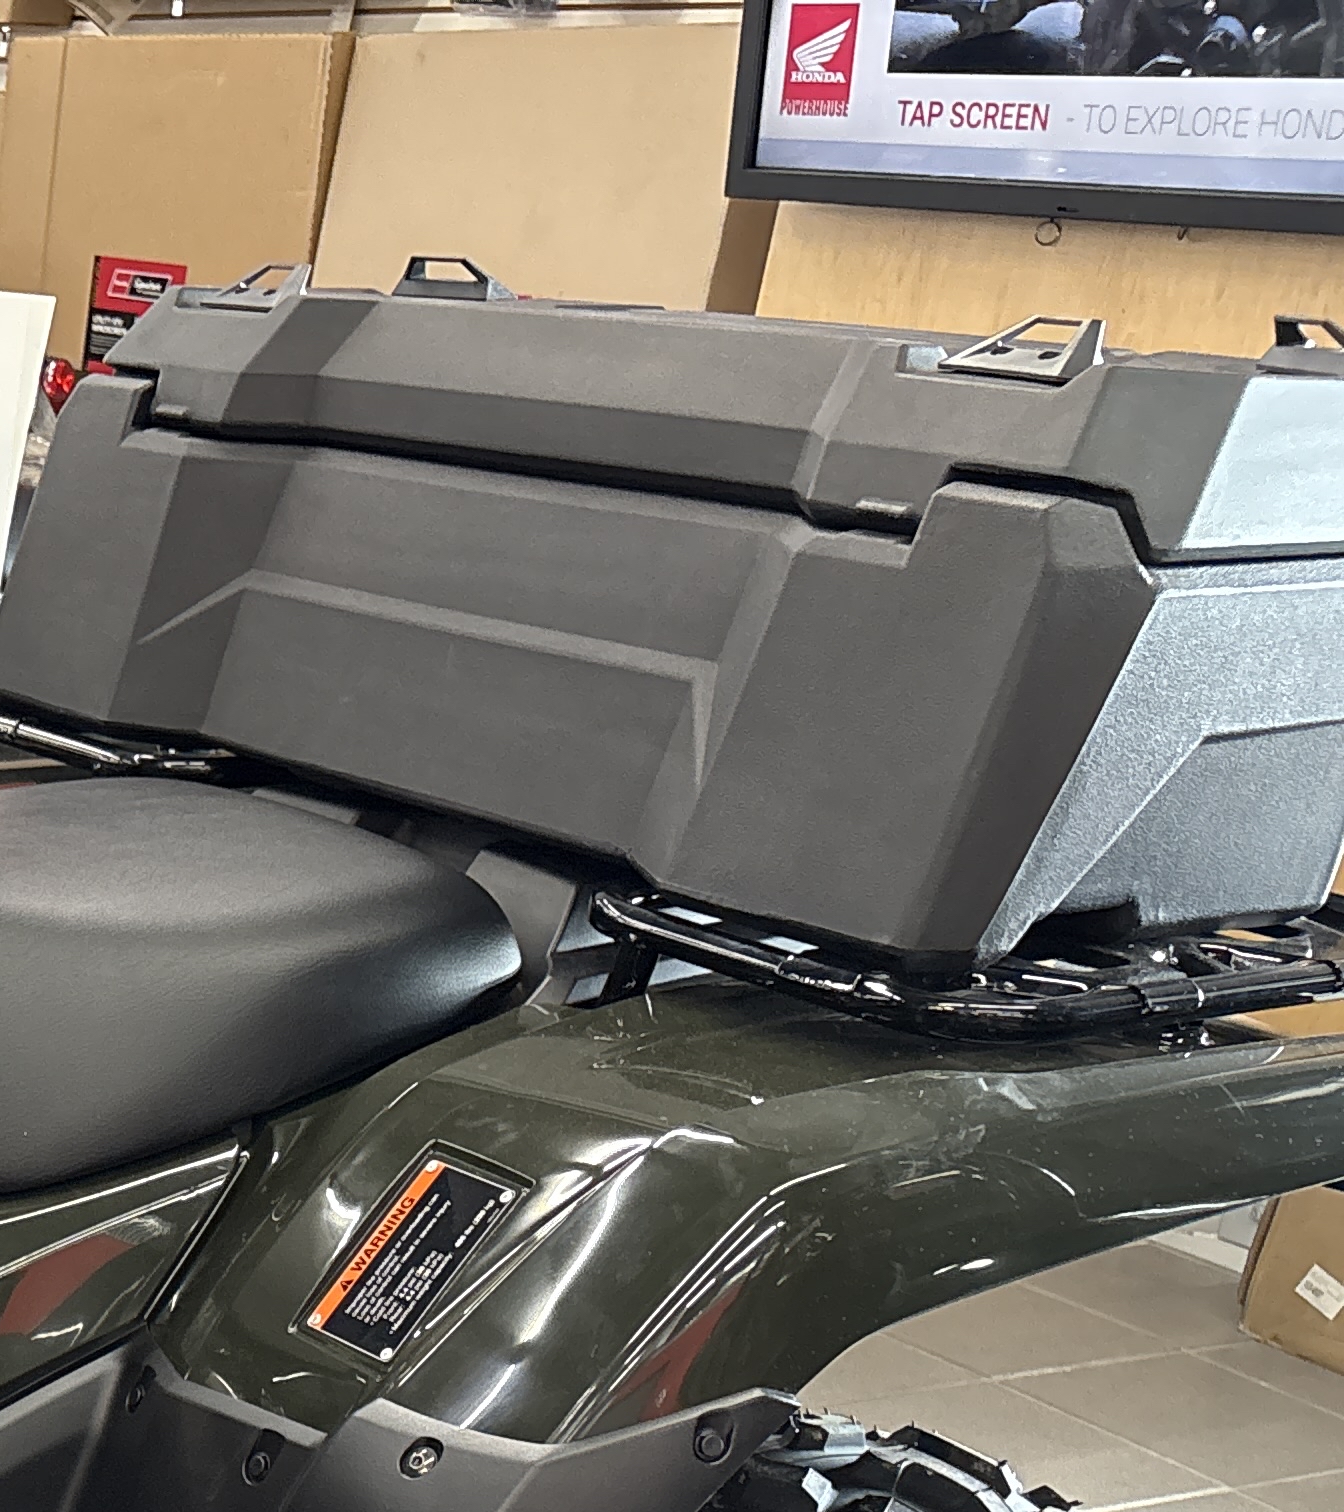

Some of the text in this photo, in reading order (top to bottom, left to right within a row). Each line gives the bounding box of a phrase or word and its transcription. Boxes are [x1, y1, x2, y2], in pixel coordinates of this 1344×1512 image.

[790, 71, 846, 84] HONDA
[780, 99, 849, 117] POWERHOUSE
[898, 100, 943, 127] TAP
[949, 101, 1050, 131] SCREEN
[1084, 104, 1117, 134] TO
[1124, 105, 1252, 138] EXPLORE
[350, 1194, 415, 1274] WARNING
